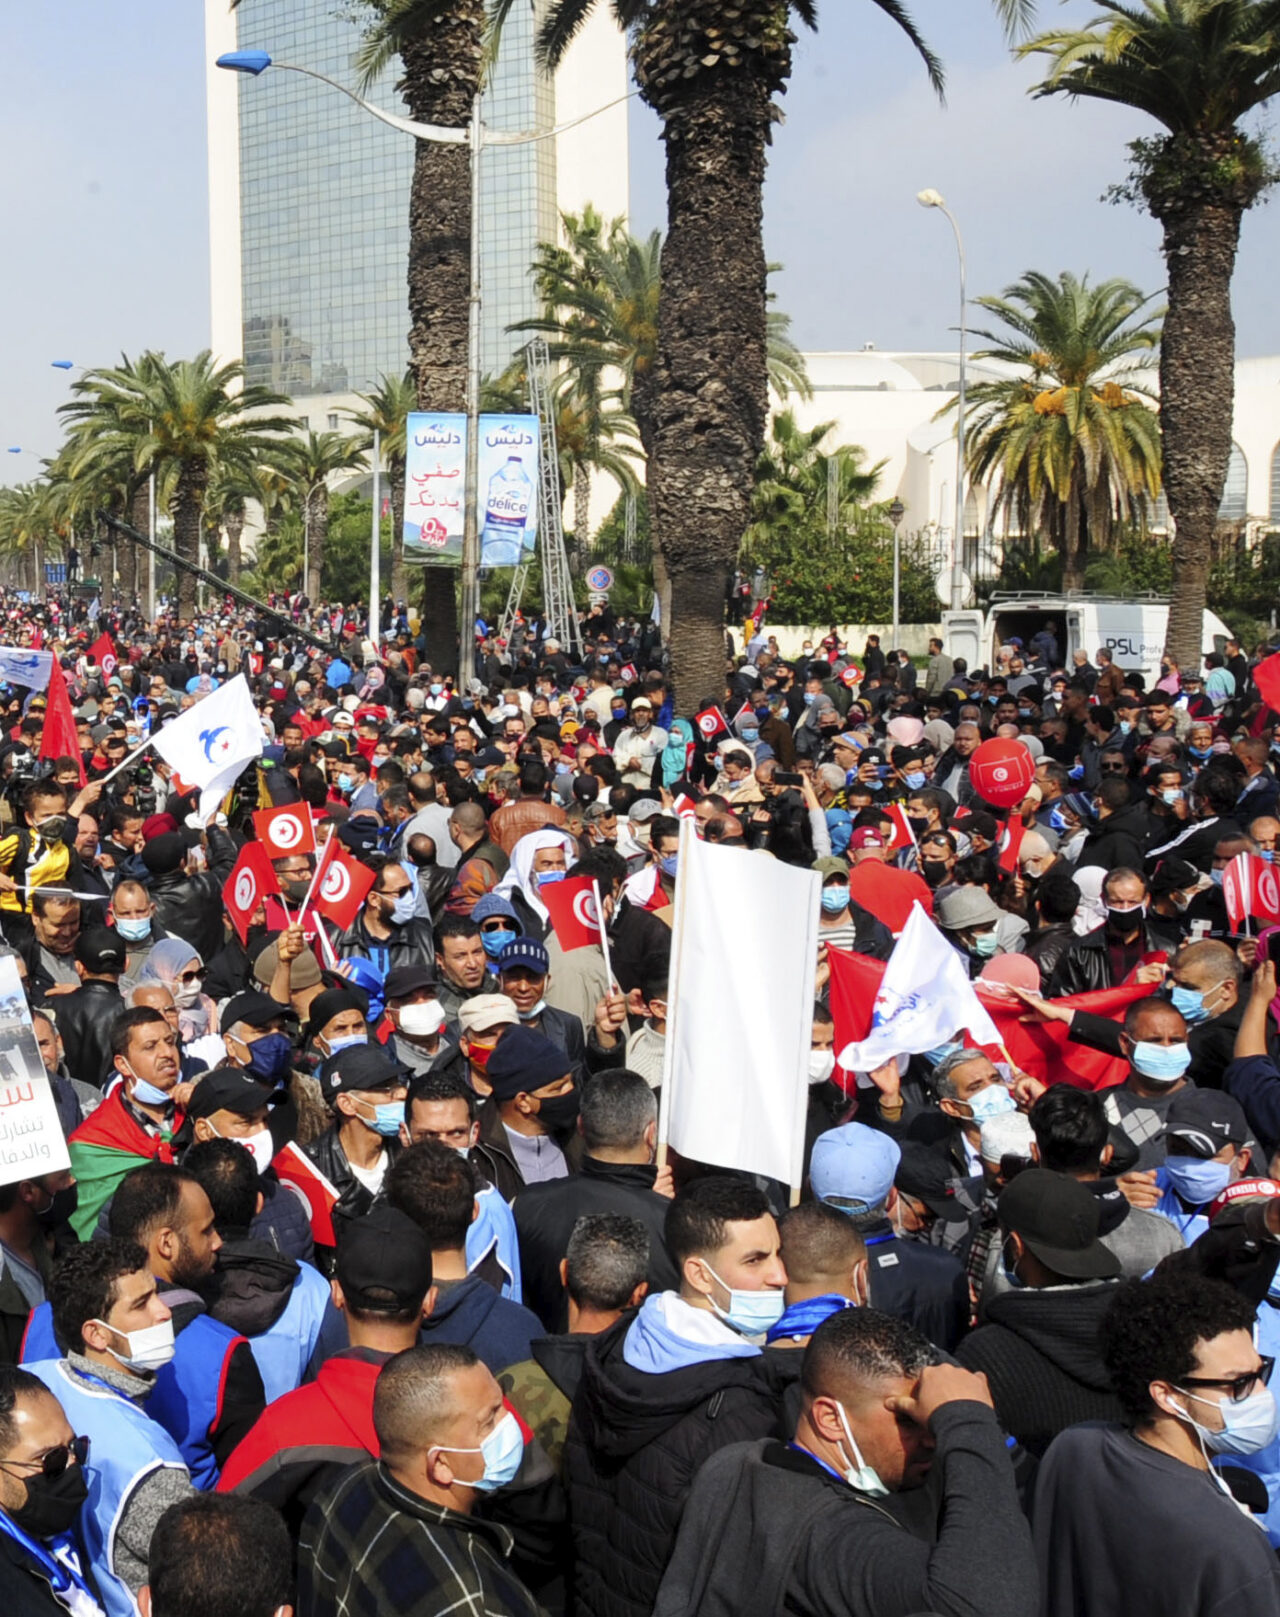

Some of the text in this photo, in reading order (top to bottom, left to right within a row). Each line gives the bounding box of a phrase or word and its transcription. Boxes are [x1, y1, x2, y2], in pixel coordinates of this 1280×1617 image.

[414, 432, 461, 448] دليس
[486, 433, 533, 449] دليس
[487, 495, 528, 513] délice
[1106, 638, 1138, 655] PSL
